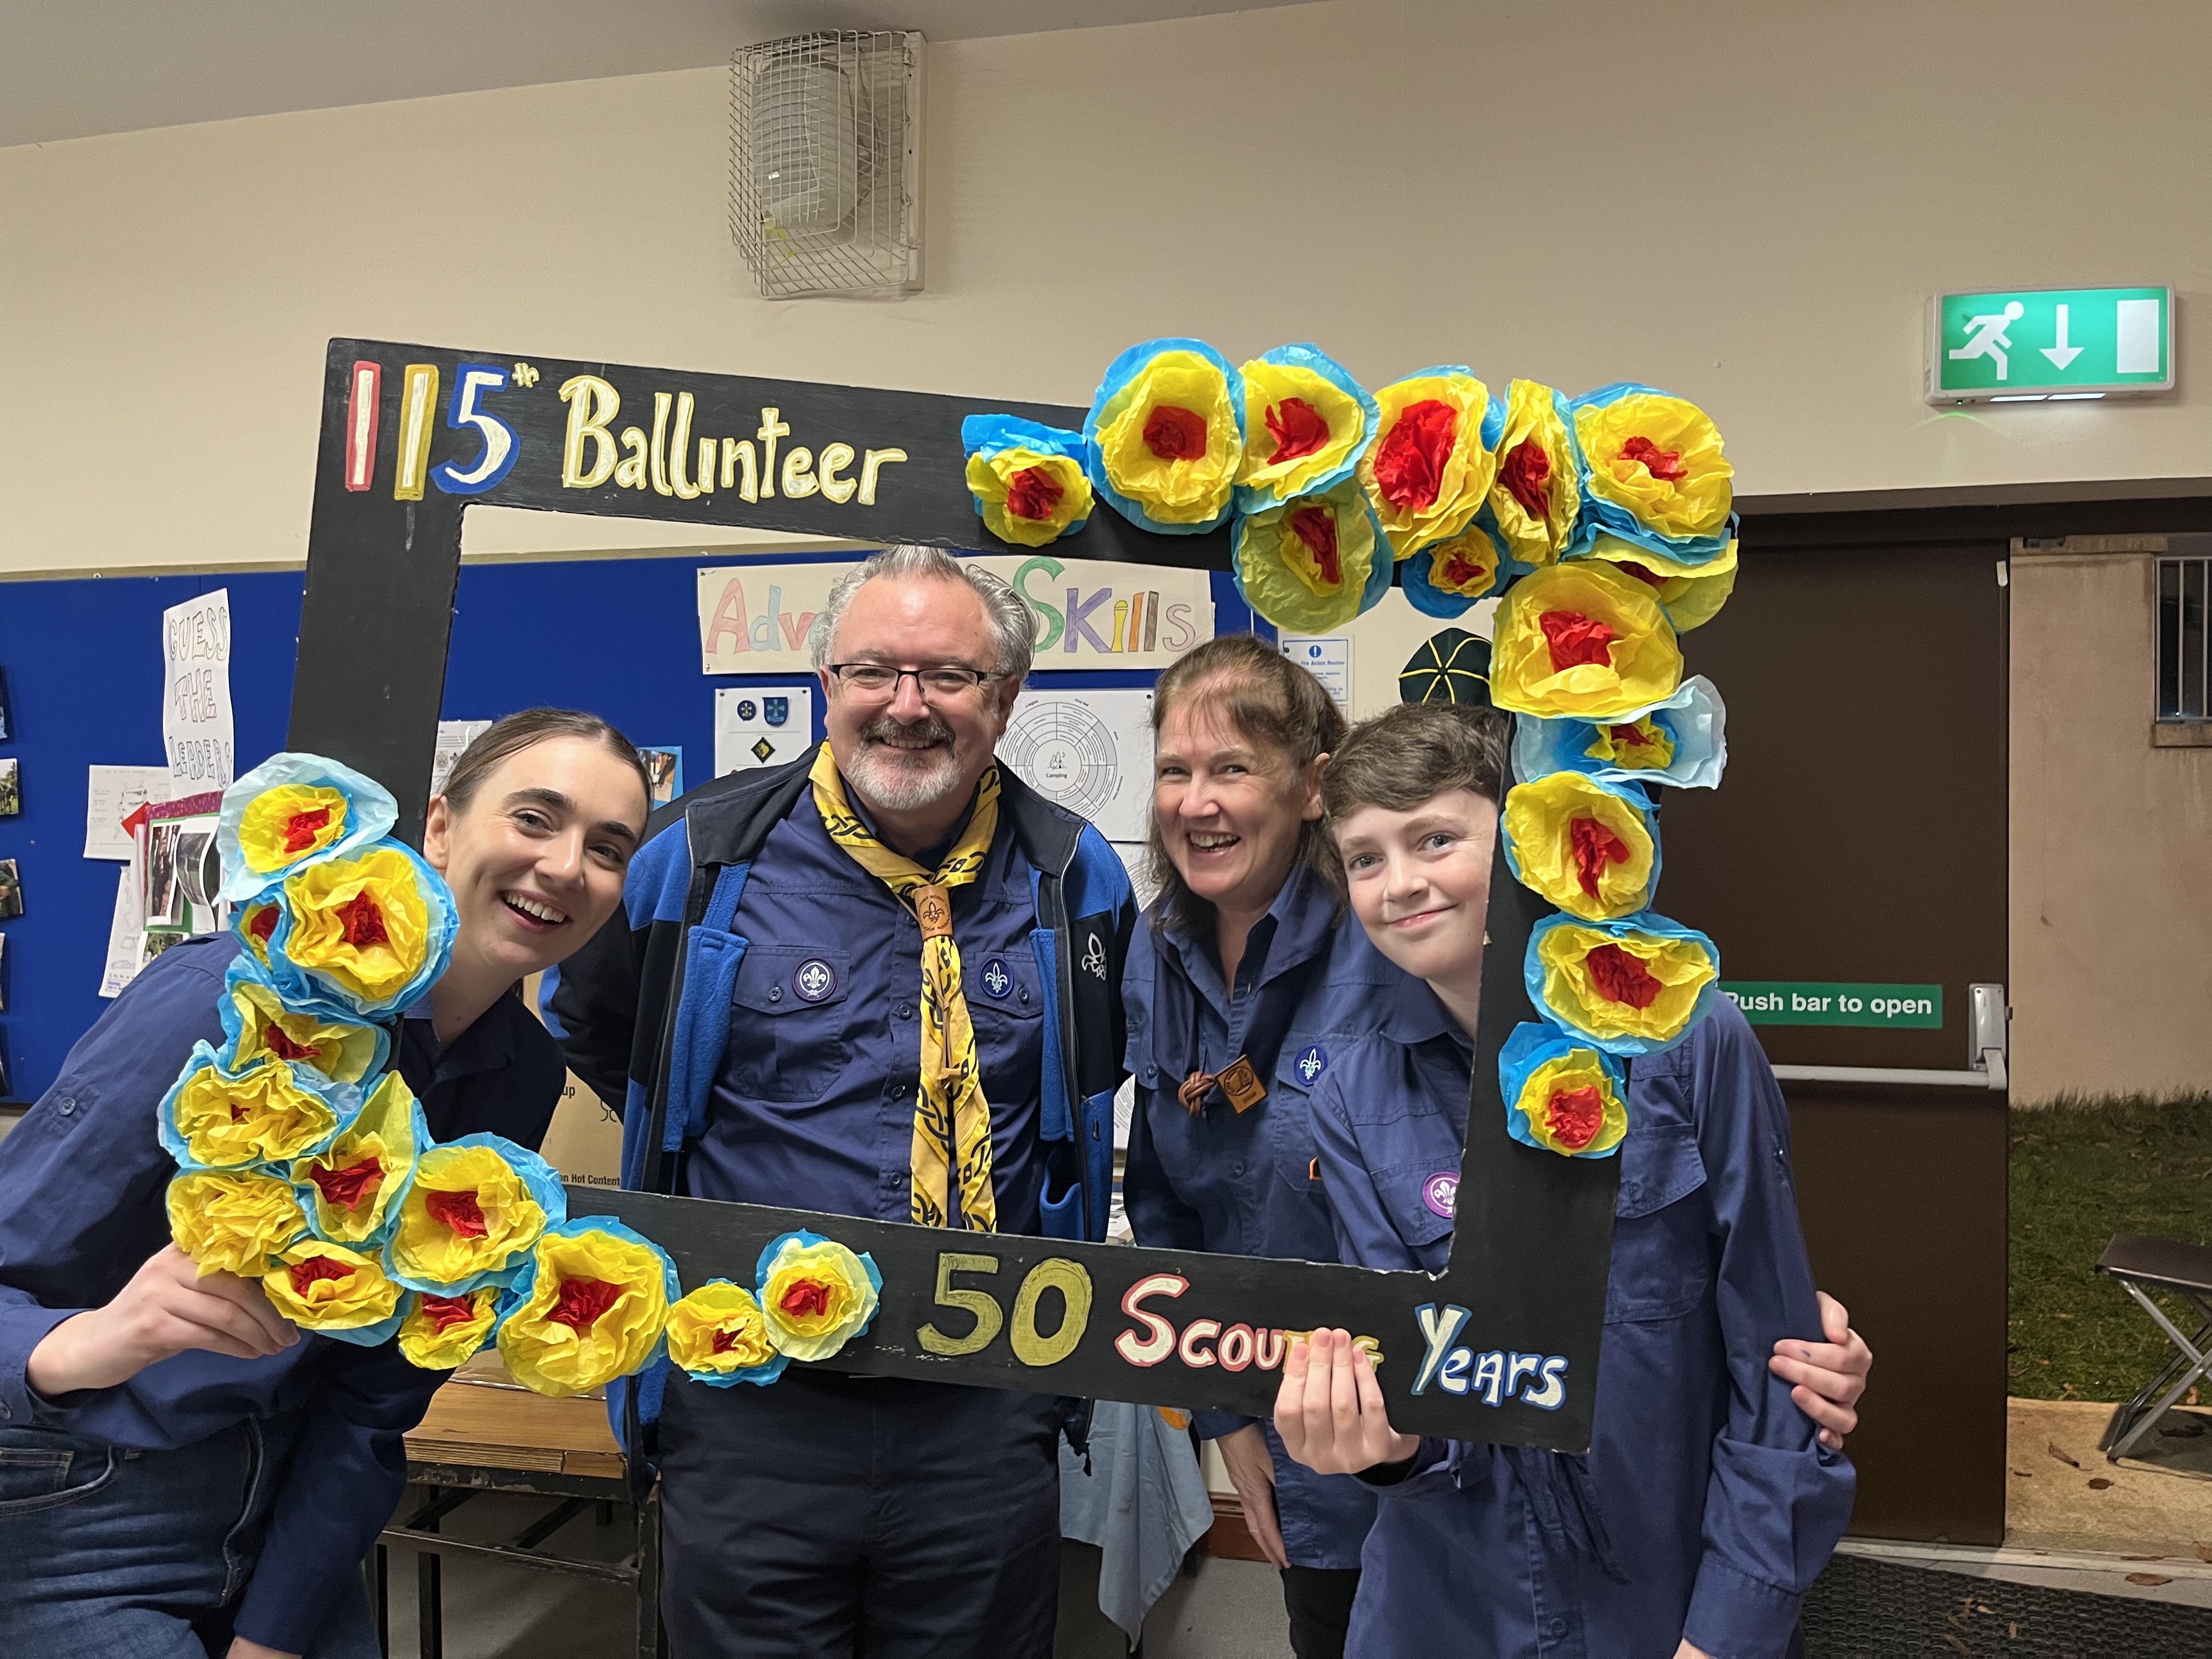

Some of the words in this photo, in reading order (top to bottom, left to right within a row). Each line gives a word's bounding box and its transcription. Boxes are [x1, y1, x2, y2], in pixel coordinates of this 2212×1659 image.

[168, 607, 228, 661] GUESS
[705, 578, 827, 654] Adv
[174, 668, 217, 723] THE
[1792, 992, 1831, 1012] bar
[1838, 995, 1863, 1013] to
[1870, 998, 1932, 1018] open
[562, 1086, 575, 1099] up
[571, 1173, 585, 1184] Hot
[917, 1252, 1093, 1367] 50
